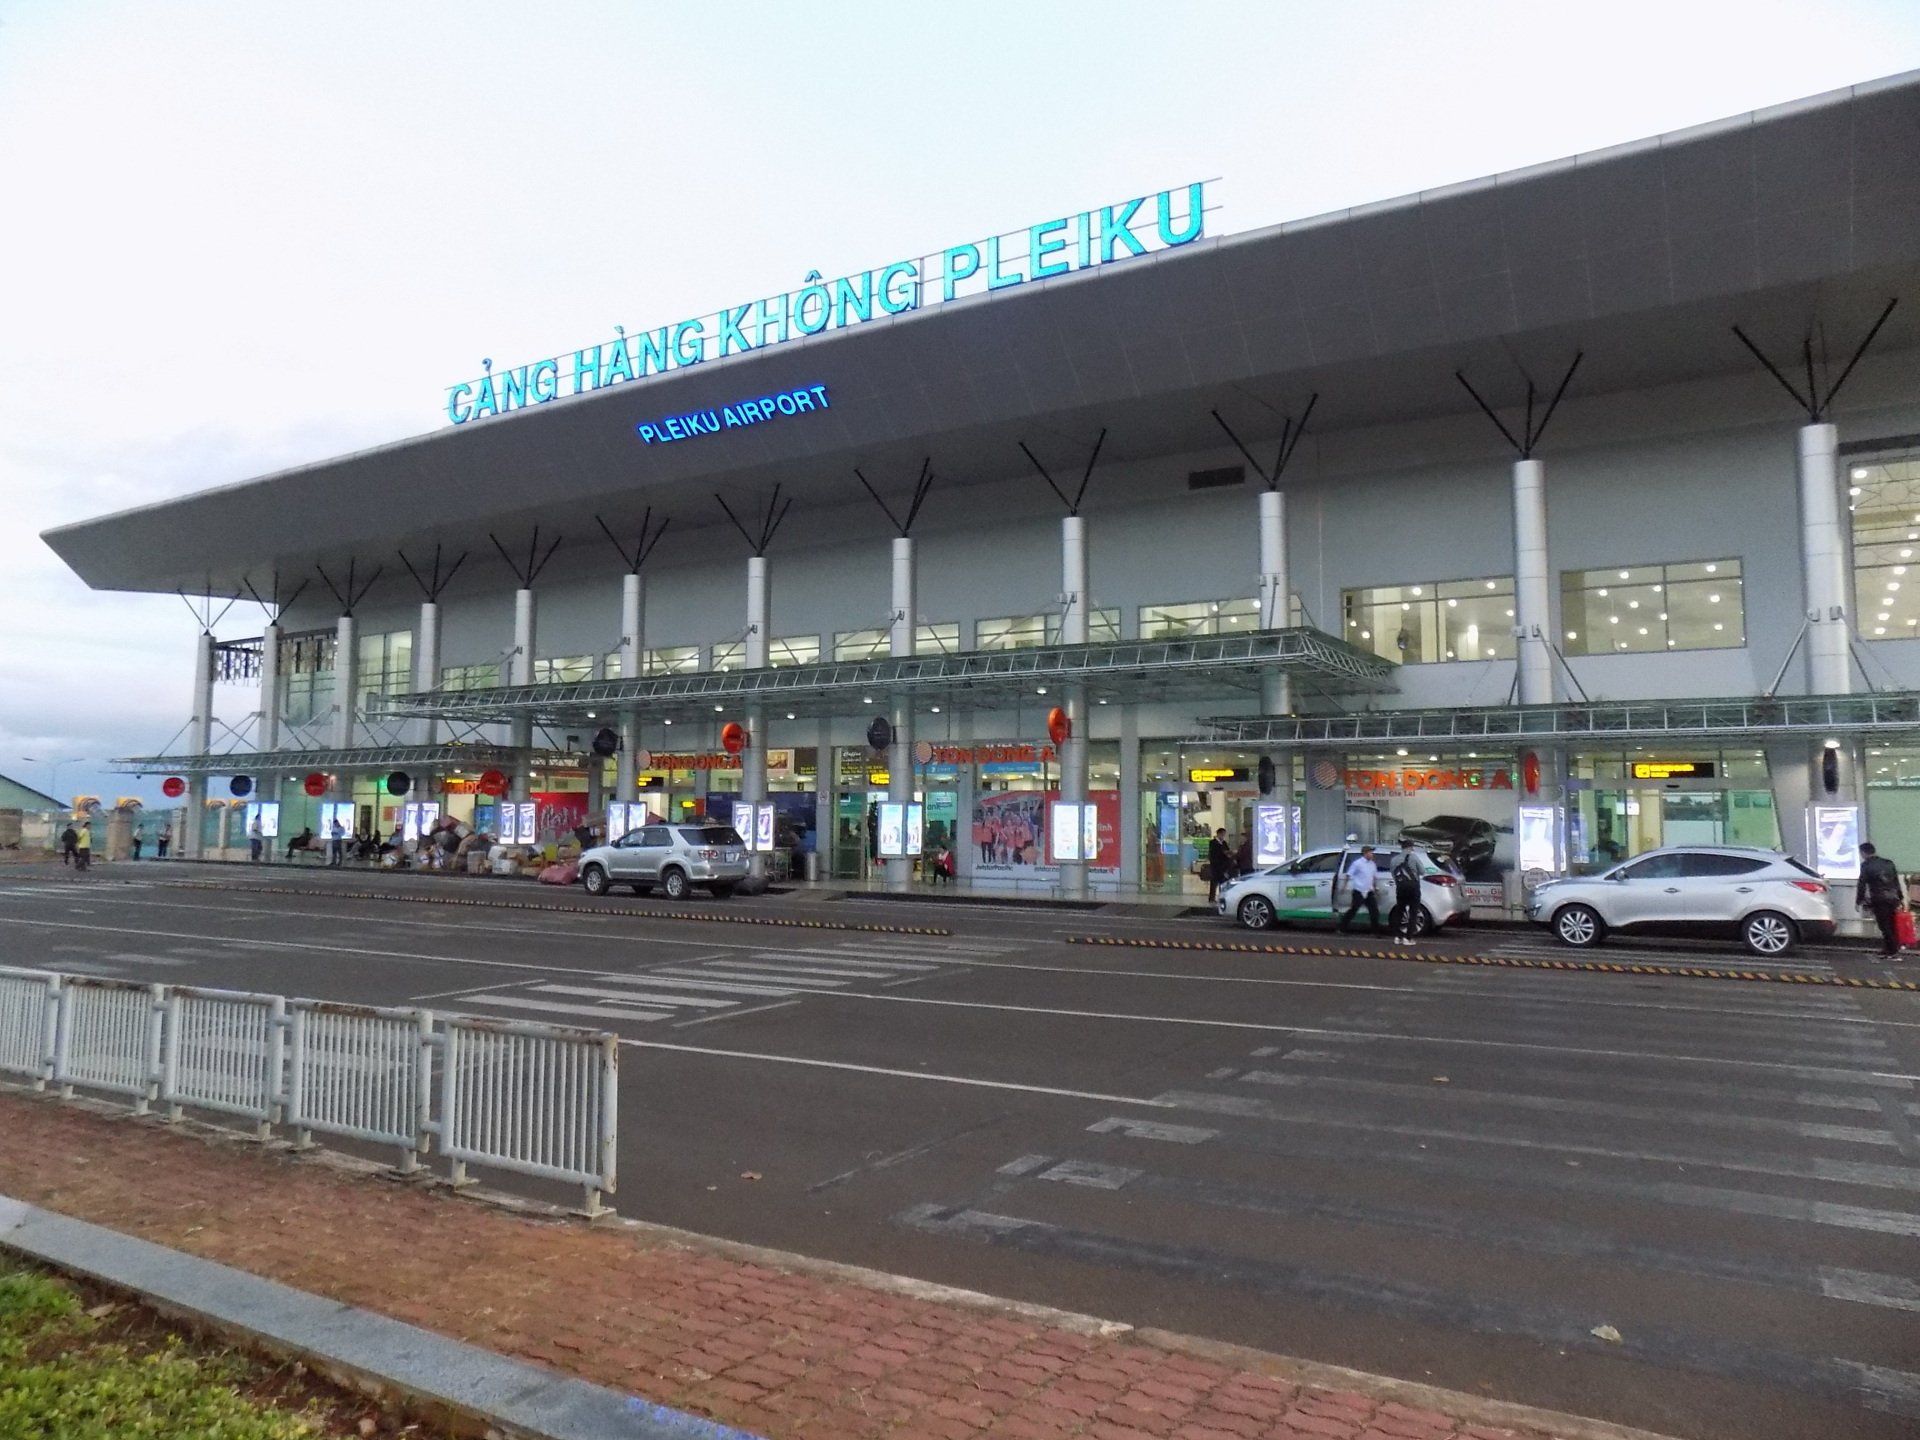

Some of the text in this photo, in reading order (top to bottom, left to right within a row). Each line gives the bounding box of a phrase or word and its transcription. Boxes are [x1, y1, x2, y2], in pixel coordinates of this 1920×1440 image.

[447, 182, 1204, 424] CẢNG HÀNG KHÔNG PLEIKU
[638, 384, 830, 444] PLEIKU AIRPORT
